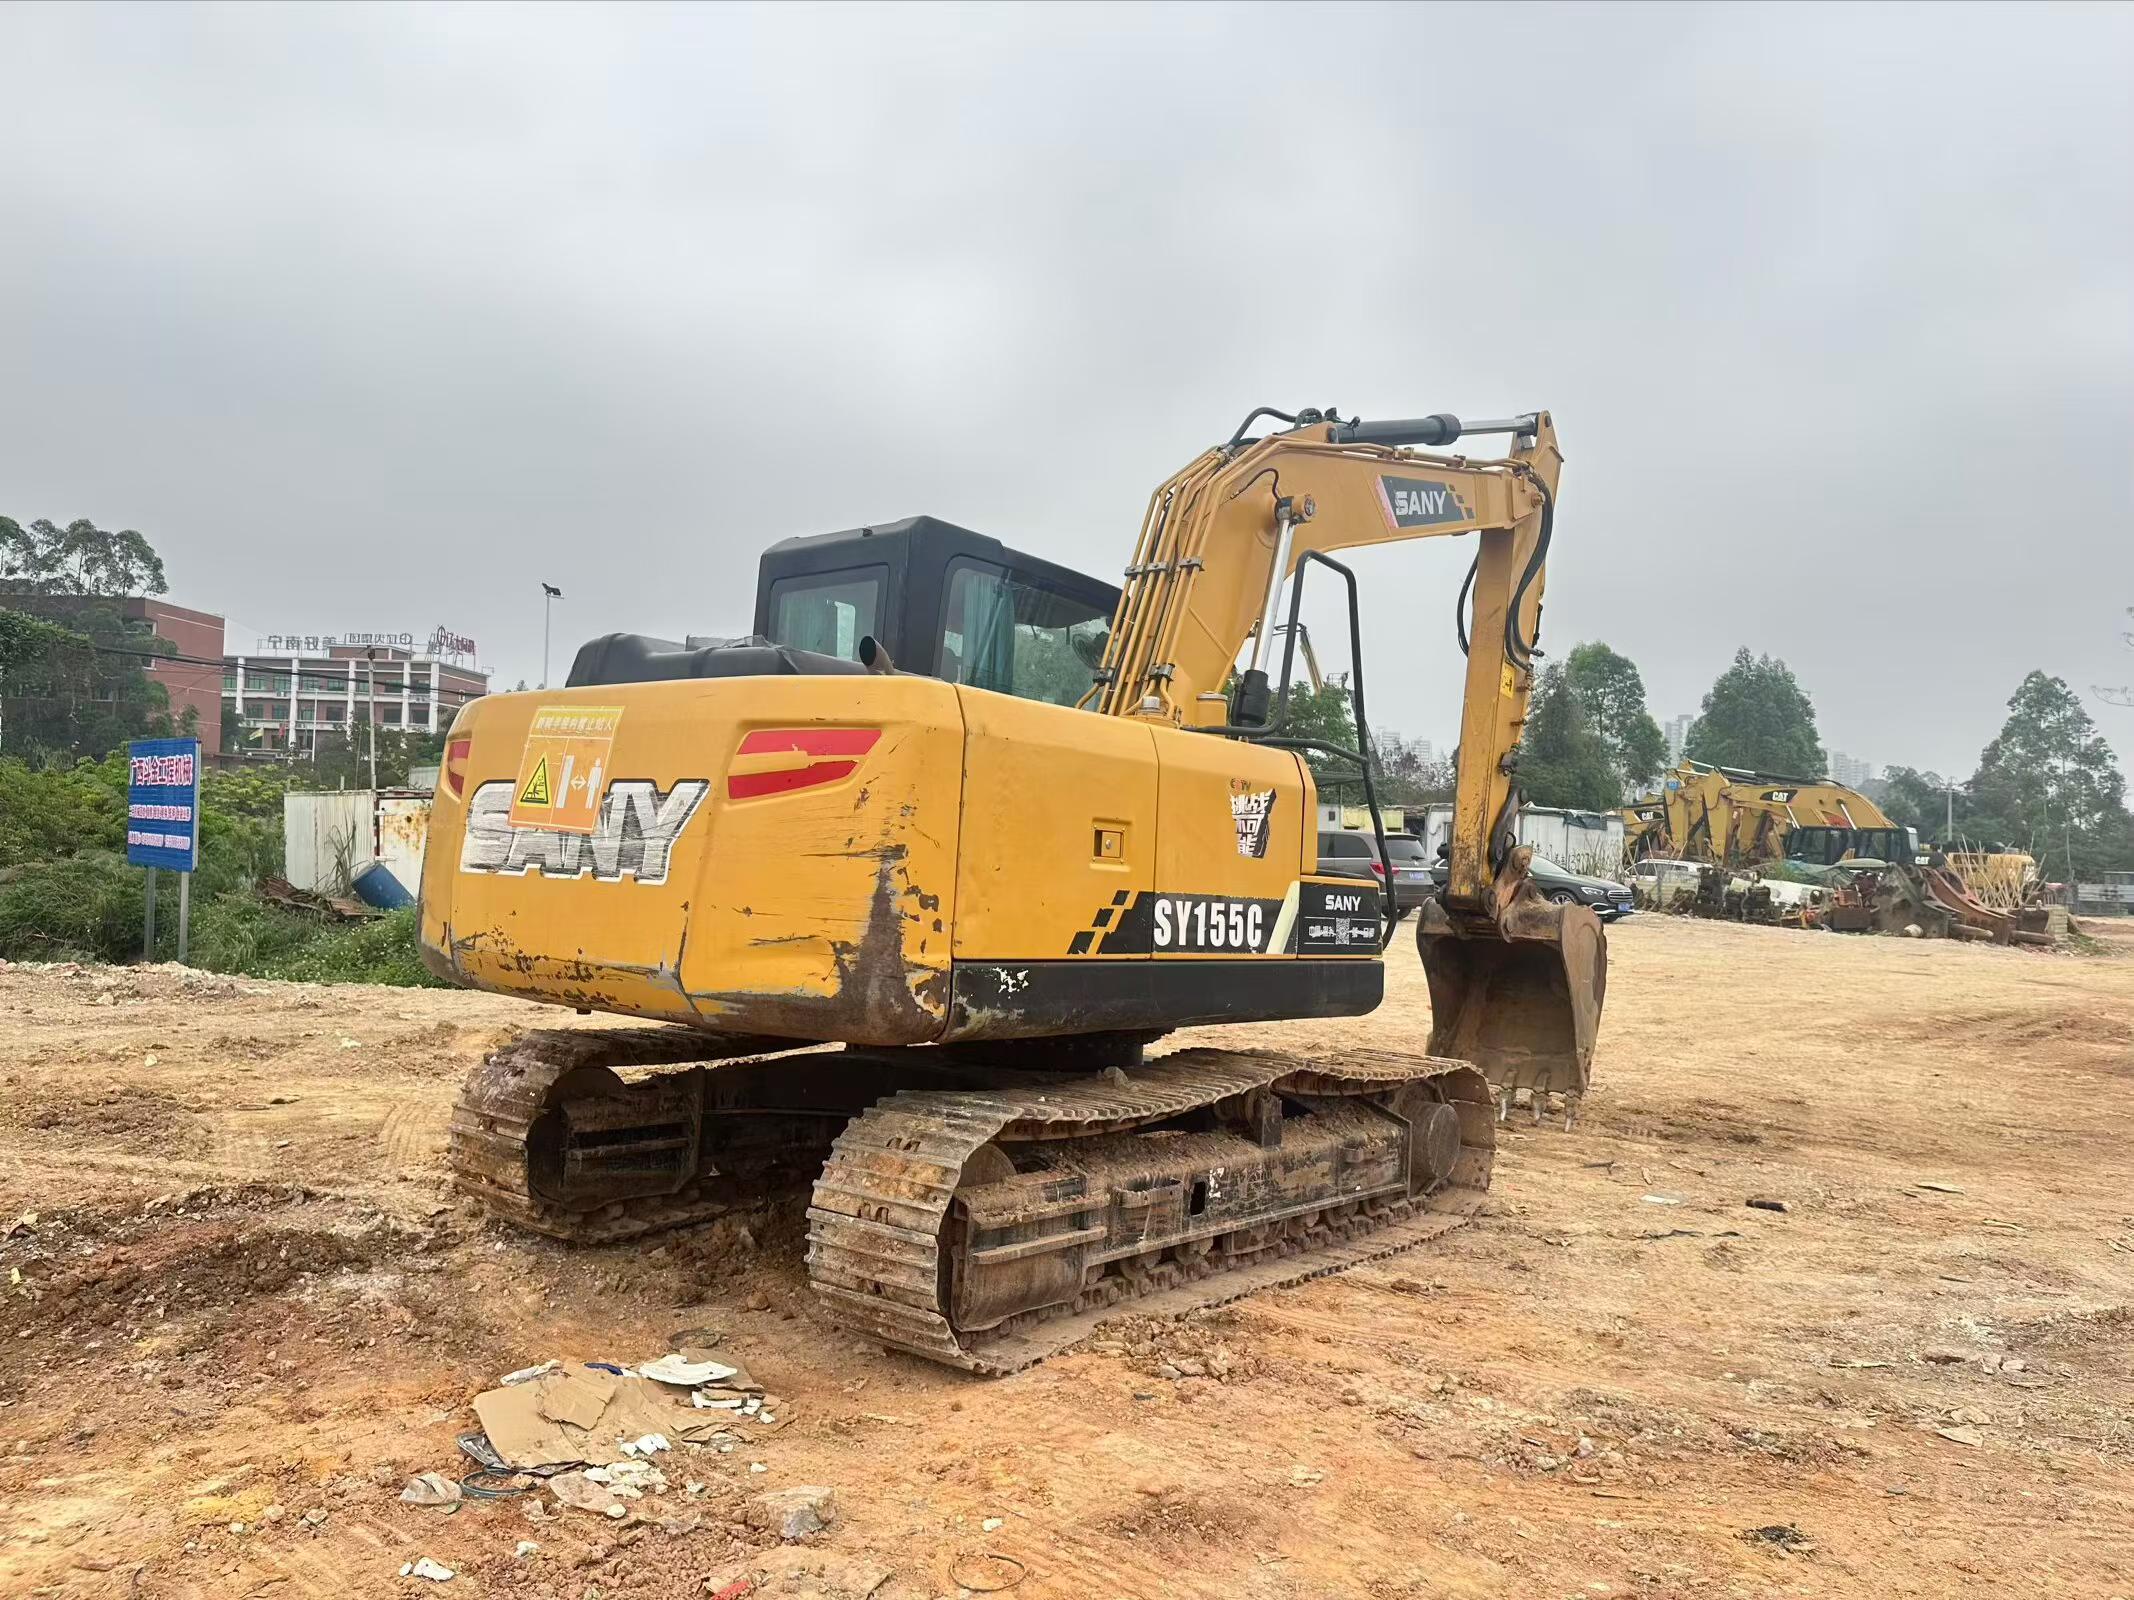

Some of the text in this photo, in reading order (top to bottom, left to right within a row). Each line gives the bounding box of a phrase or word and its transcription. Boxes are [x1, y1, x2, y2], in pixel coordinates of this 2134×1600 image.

[1394, 490, 1446, 516] SANY
[1230, 789, 1273, 815] 挑战
[1771, 791, 1789, 803] CAT
[460, 778, 711, 886] SANY
[1231, 813, 1265, 836] 不可
[1236, 833, 1258, 857] 能
[1914, 856, 1930, 865] CAT
[1325, 894, 1361, 912] SANY
[1153, 898, 1263, 948] SY155C
